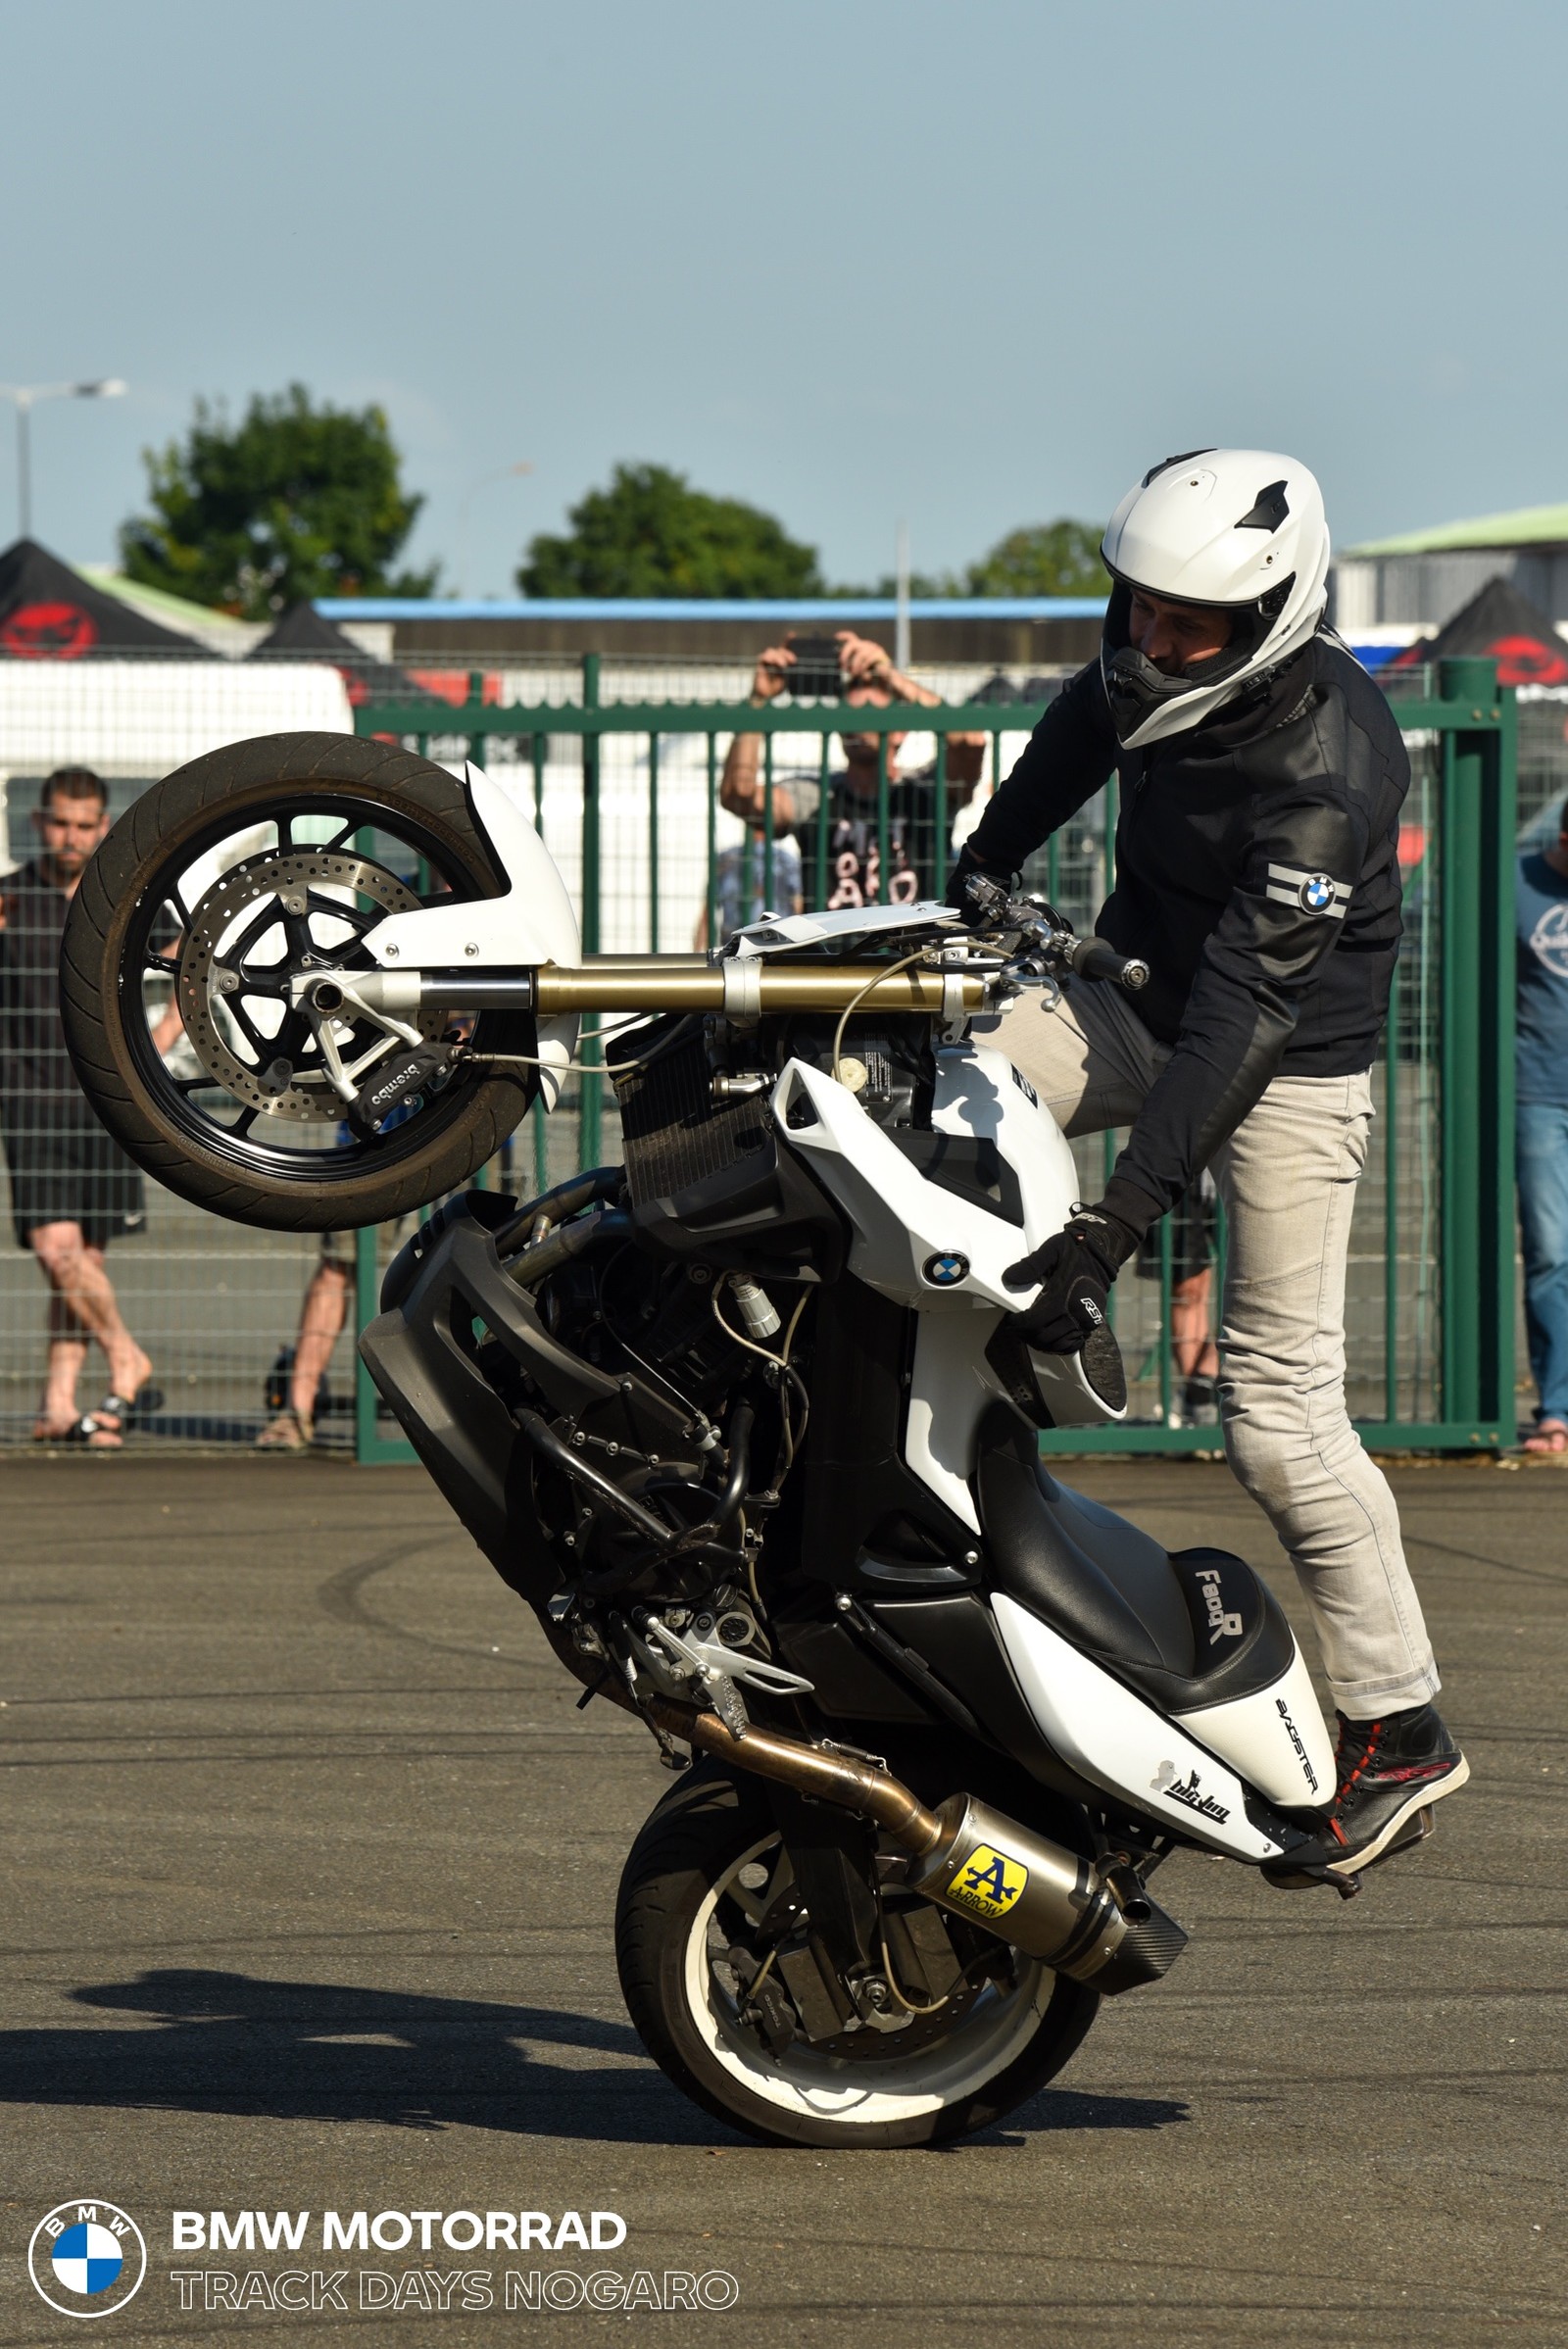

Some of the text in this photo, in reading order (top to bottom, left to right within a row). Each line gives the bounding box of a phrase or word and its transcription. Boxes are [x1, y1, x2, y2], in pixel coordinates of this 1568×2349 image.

[1307, 875, 1335, 893] BMW
[370, 1063, 421, 1105] brembo
[1195, 1569, 1244, 1645] F800R
[1275, 1698, 1319, 1795] BAGSTER
[949, 1886, 1004, 1916] ARROW
[764, 1993, 781, 2030] TOKICO
